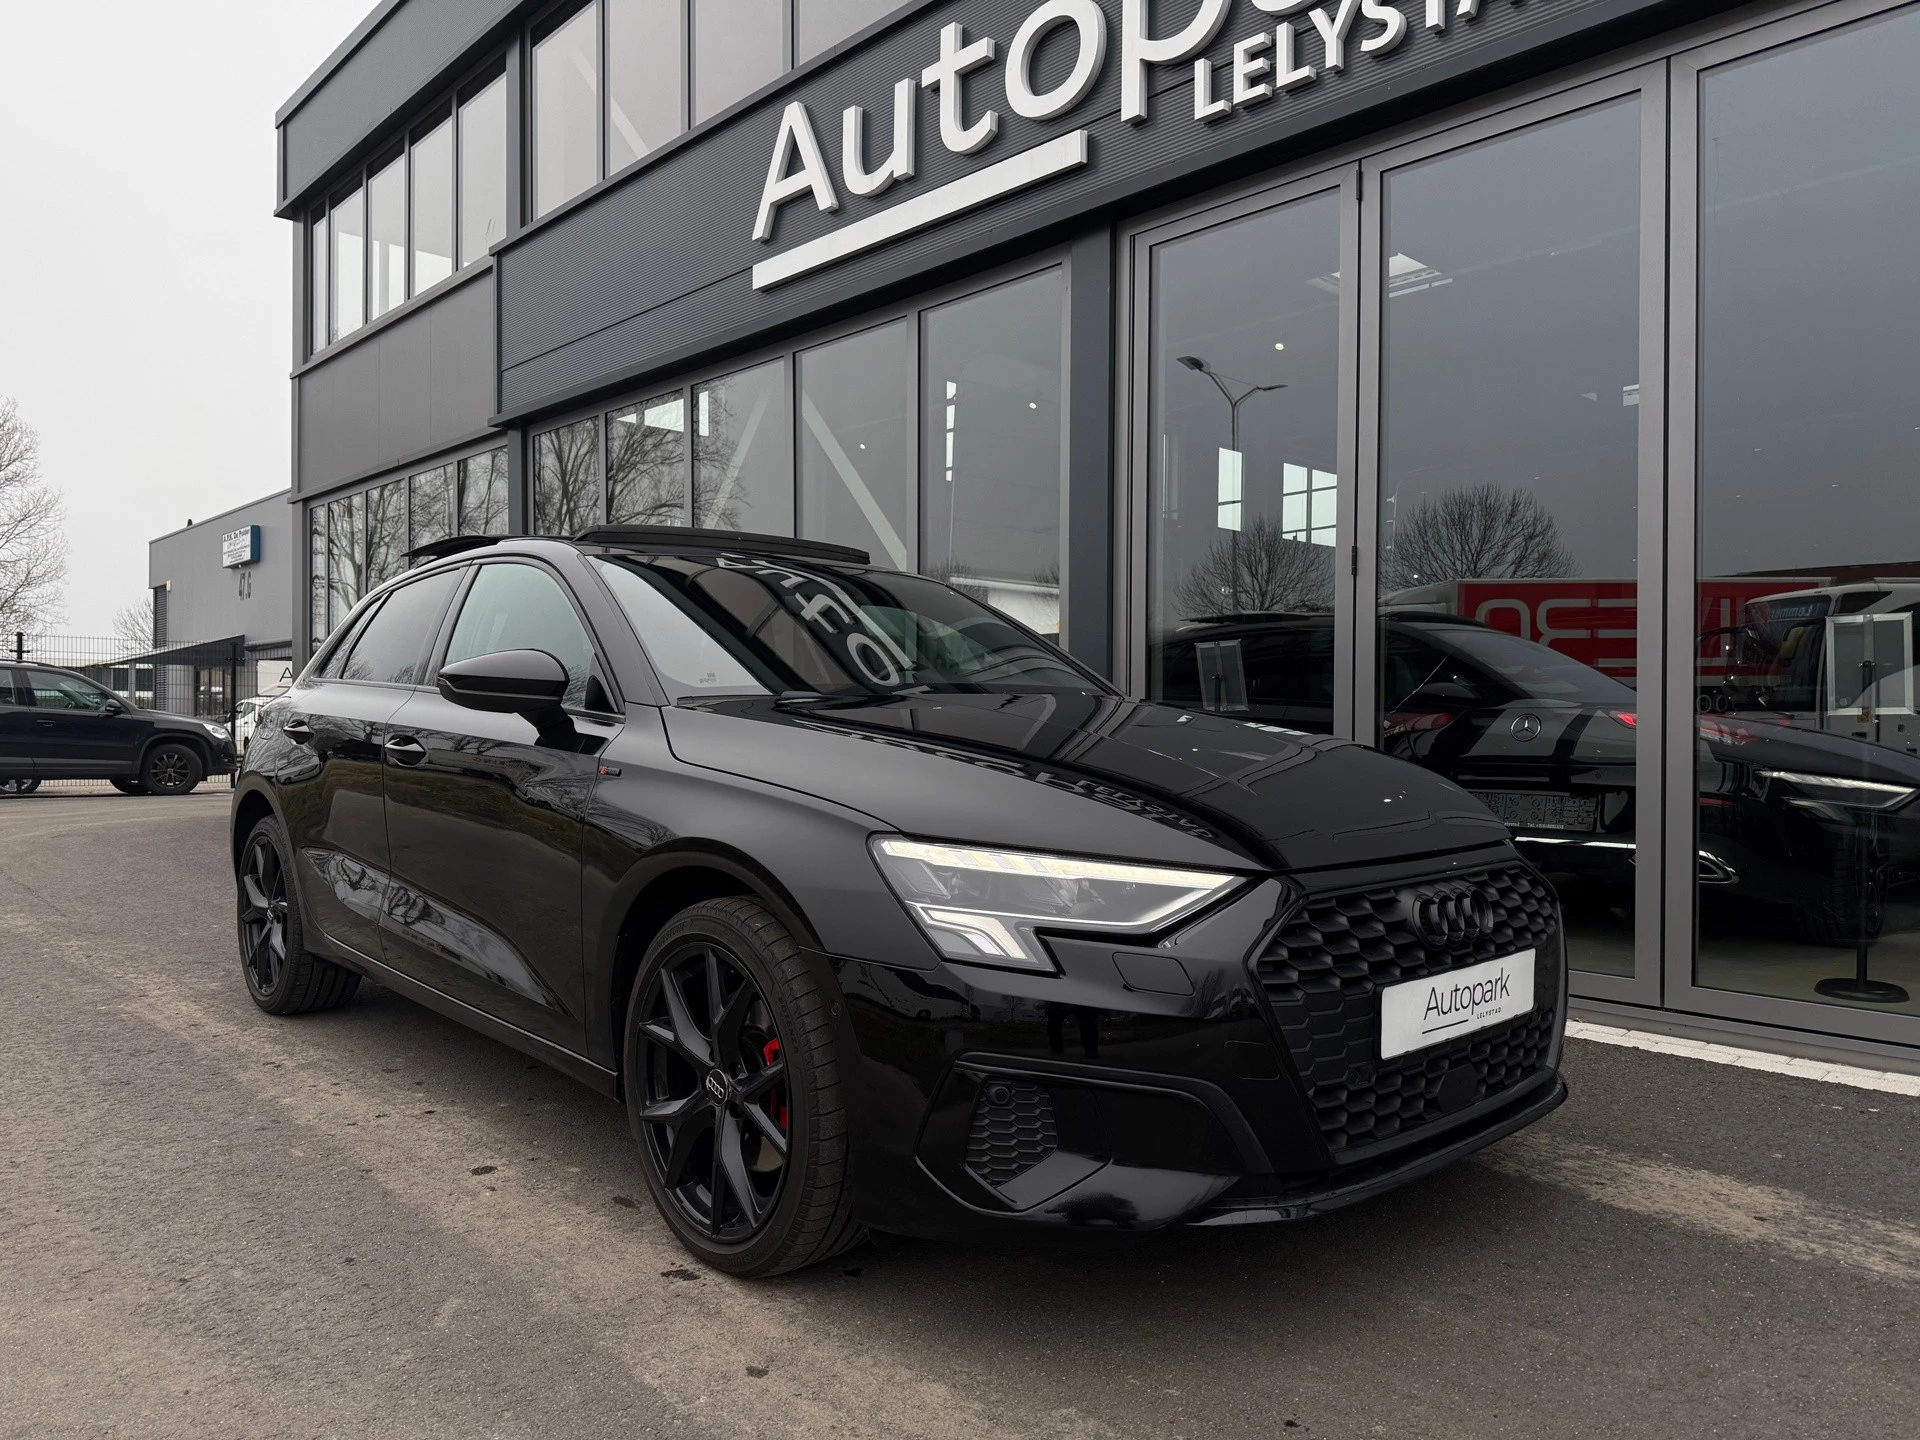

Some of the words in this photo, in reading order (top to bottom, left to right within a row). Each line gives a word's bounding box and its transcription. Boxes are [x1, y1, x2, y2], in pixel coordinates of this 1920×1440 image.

[1194, 0, 1480, 121] LELYS
[751, 0, 1320, 243] Autop
[1423, 967, 1511, 1021] Autopark
[1476, 1006, 1502, 1020] LELYSTAD
